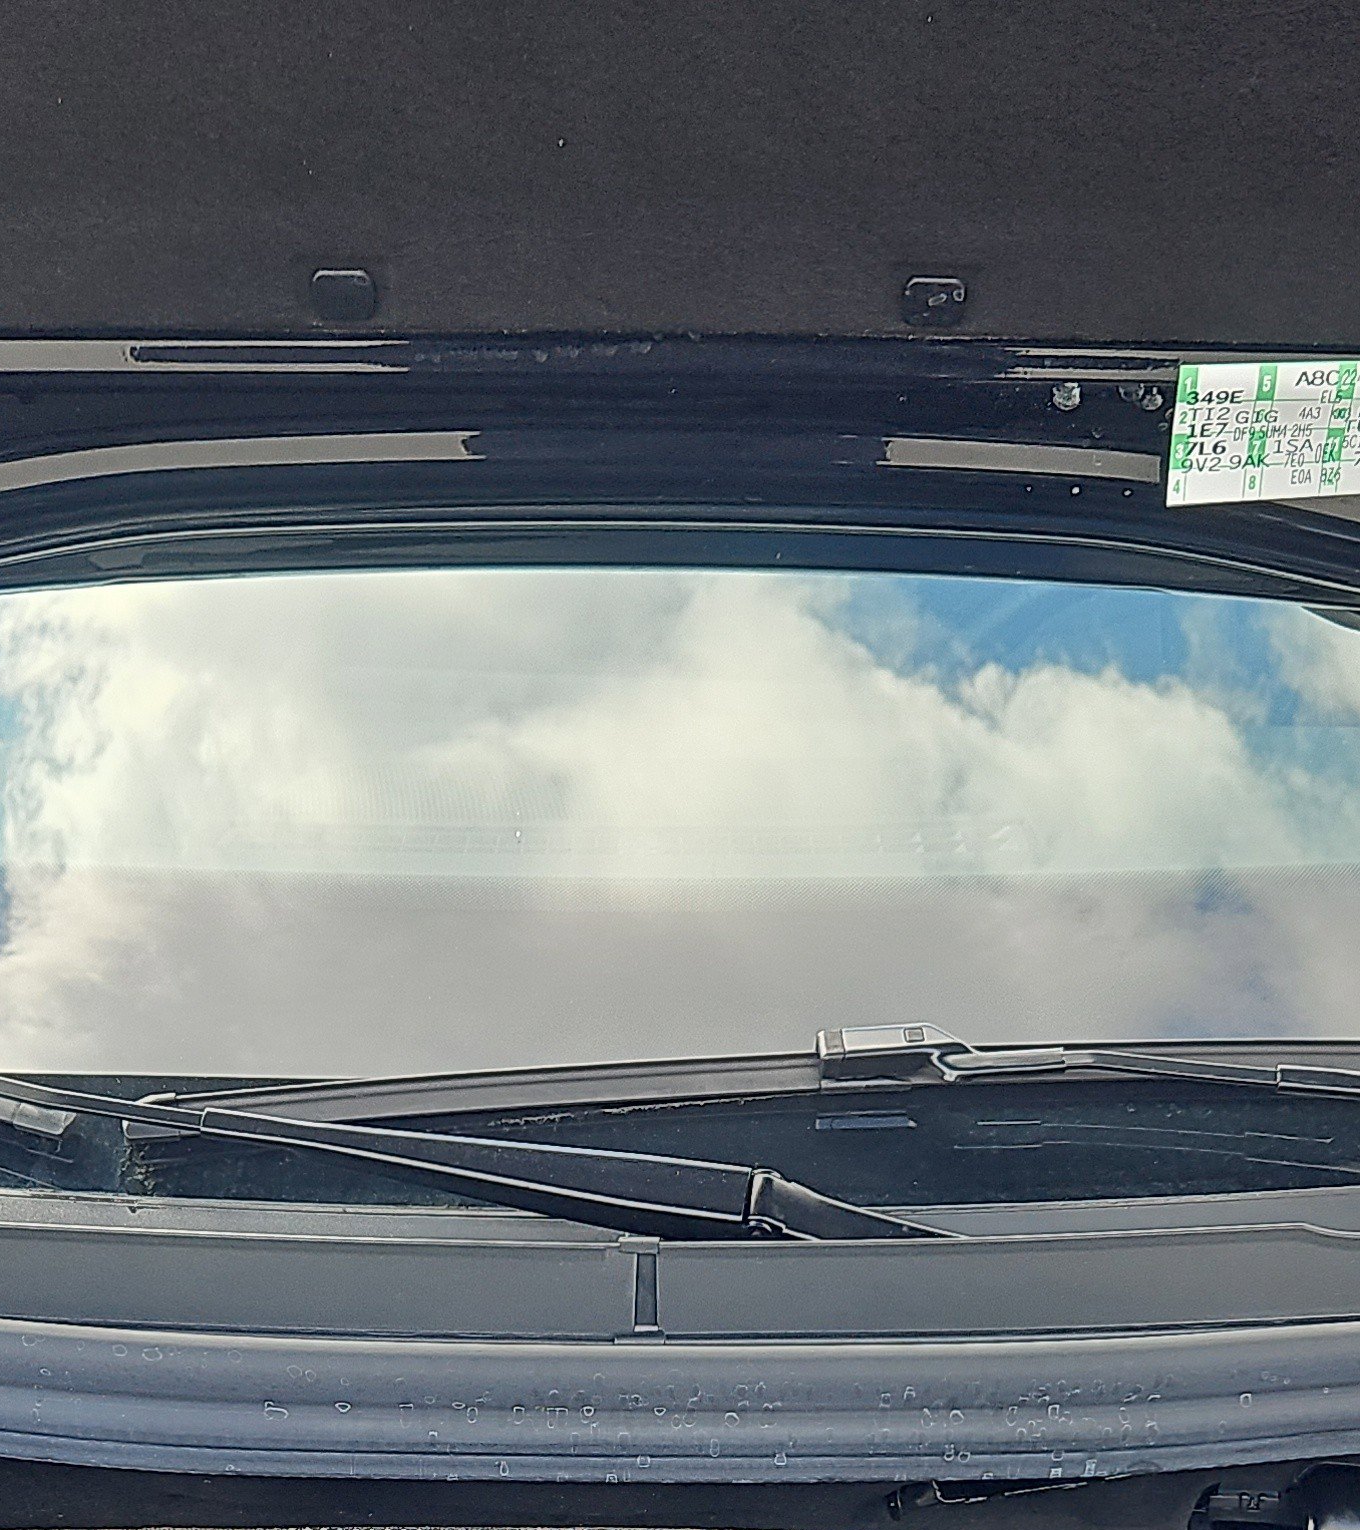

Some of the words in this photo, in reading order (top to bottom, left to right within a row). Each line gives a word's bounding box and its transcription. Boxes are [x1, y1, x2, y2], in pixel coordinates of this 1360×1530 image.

[1186, 389, 1245, 406] 349E
[1186, 422, 1229, 439] 1E7
[1185, 440, 1228, 458] 7L6
[1181, 457, 1221, 474] 9V2
[1229, 452, 1270, 469] 9AK
